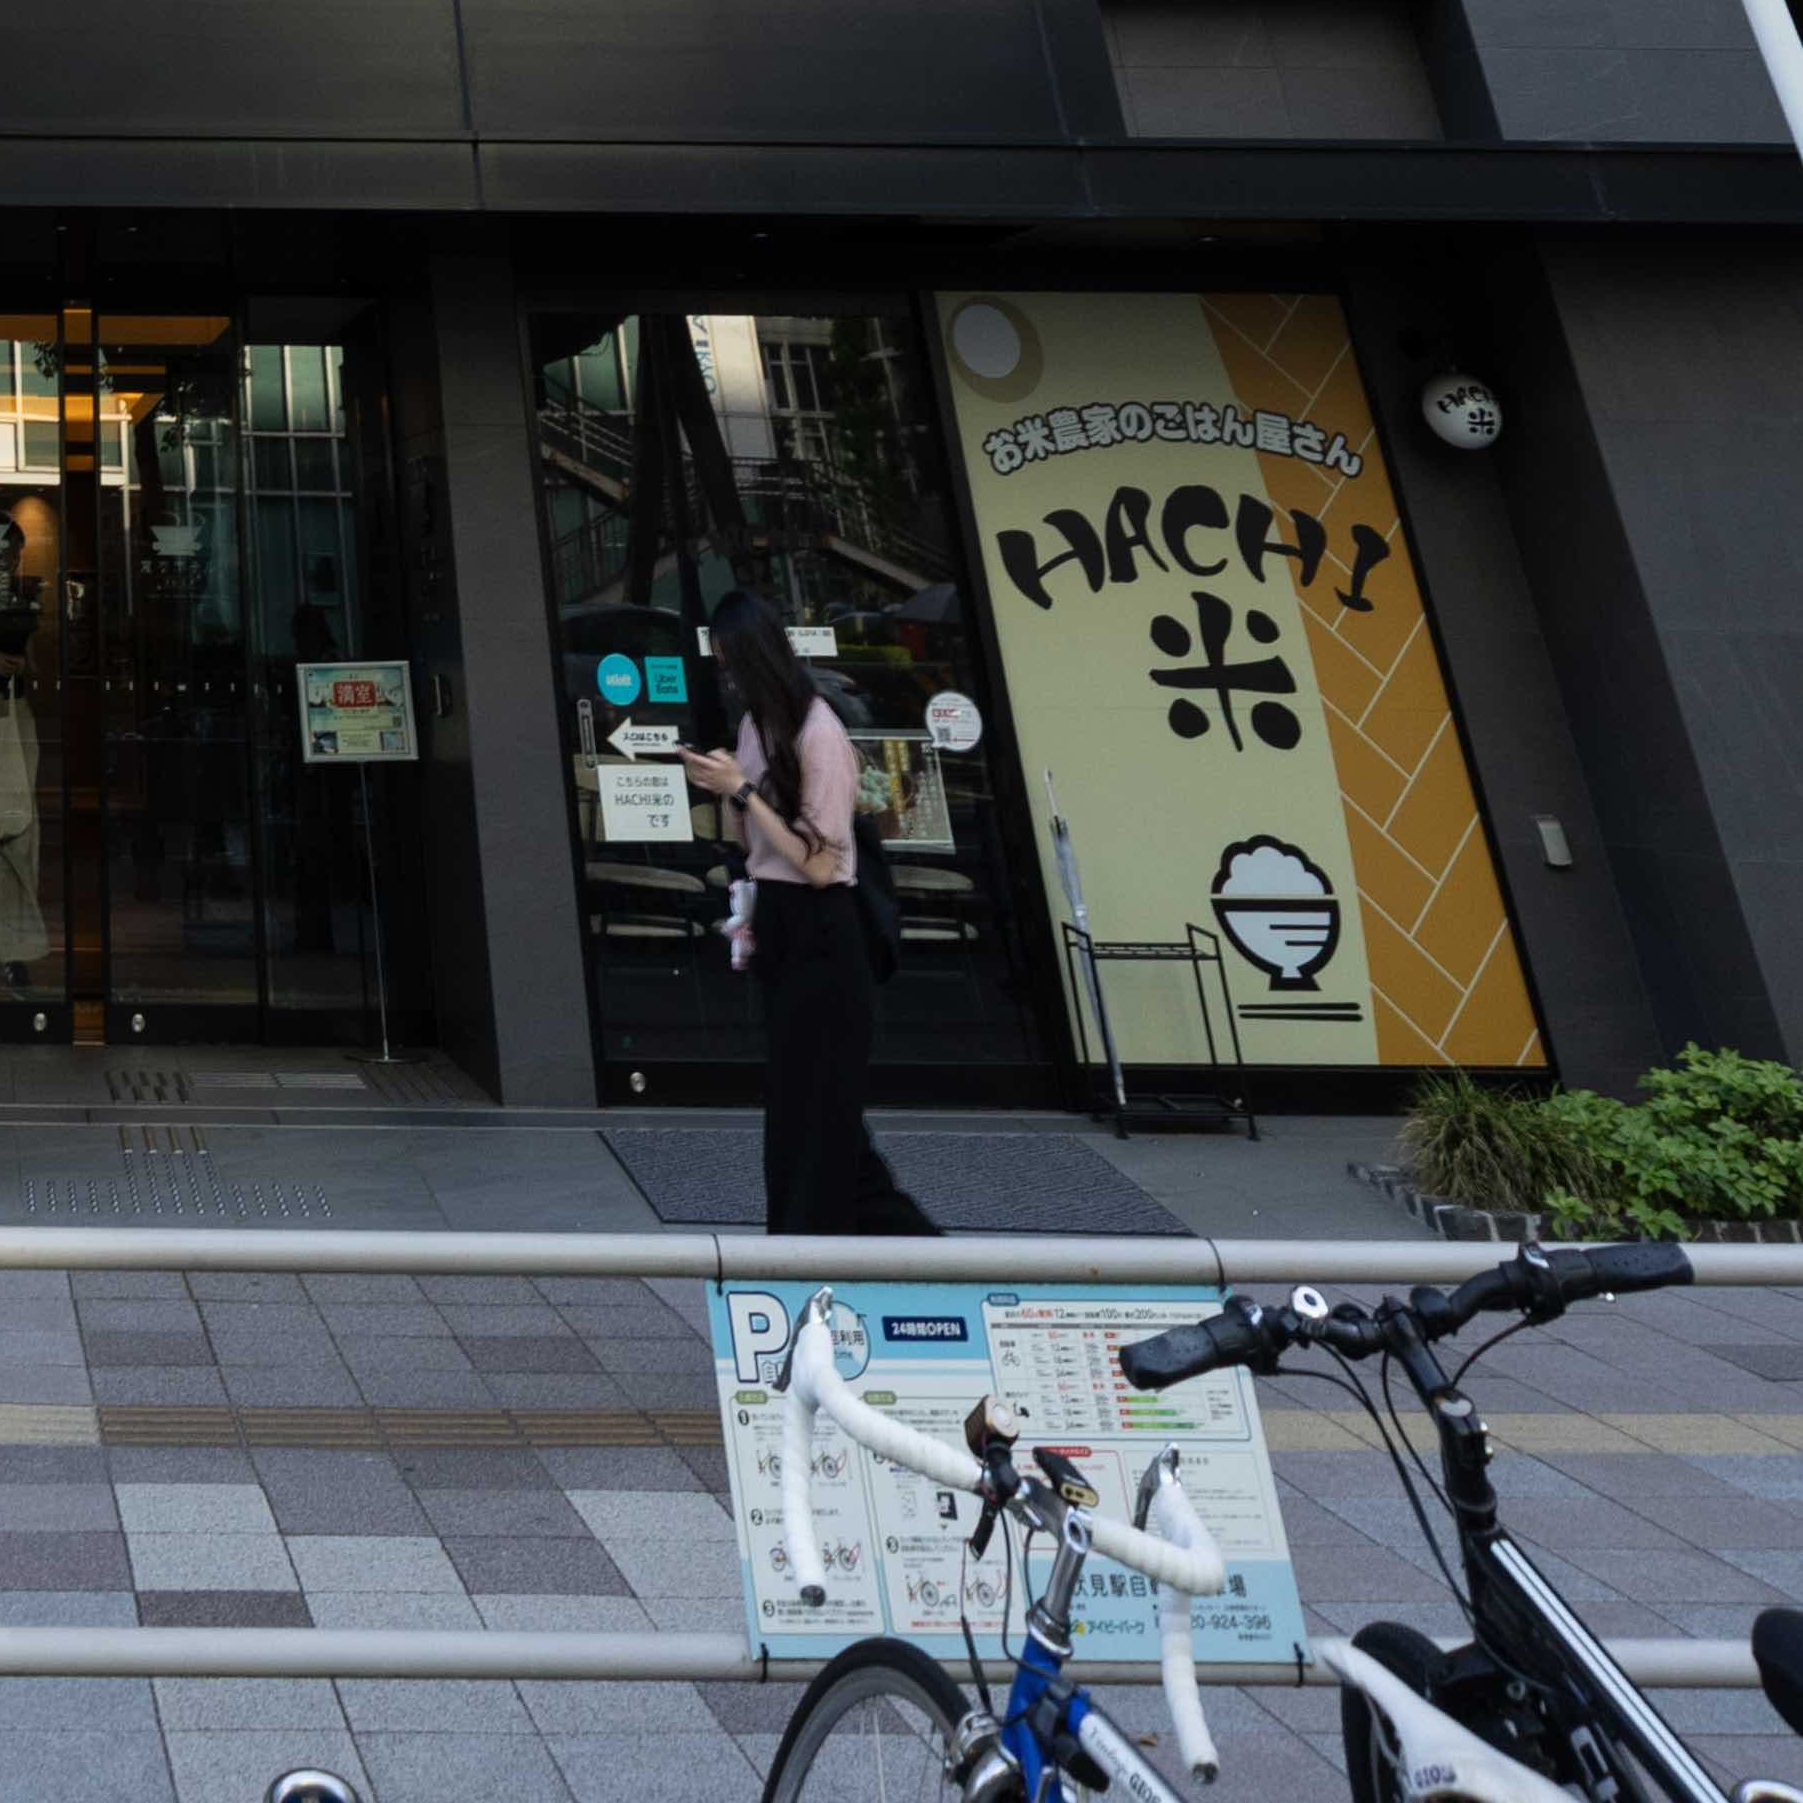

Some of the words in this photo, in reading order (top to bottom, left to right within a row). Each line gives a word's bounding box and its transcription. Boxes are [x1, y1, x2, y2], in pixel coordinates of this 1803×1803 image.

[982, 401, 1364, 477] お米農家のごはん屋さん
[996, 484, 1389, 612] HACHI
[726, 1291, 790, 1383] P
[892, 1322, 961, 1336] 24時間OPEN
